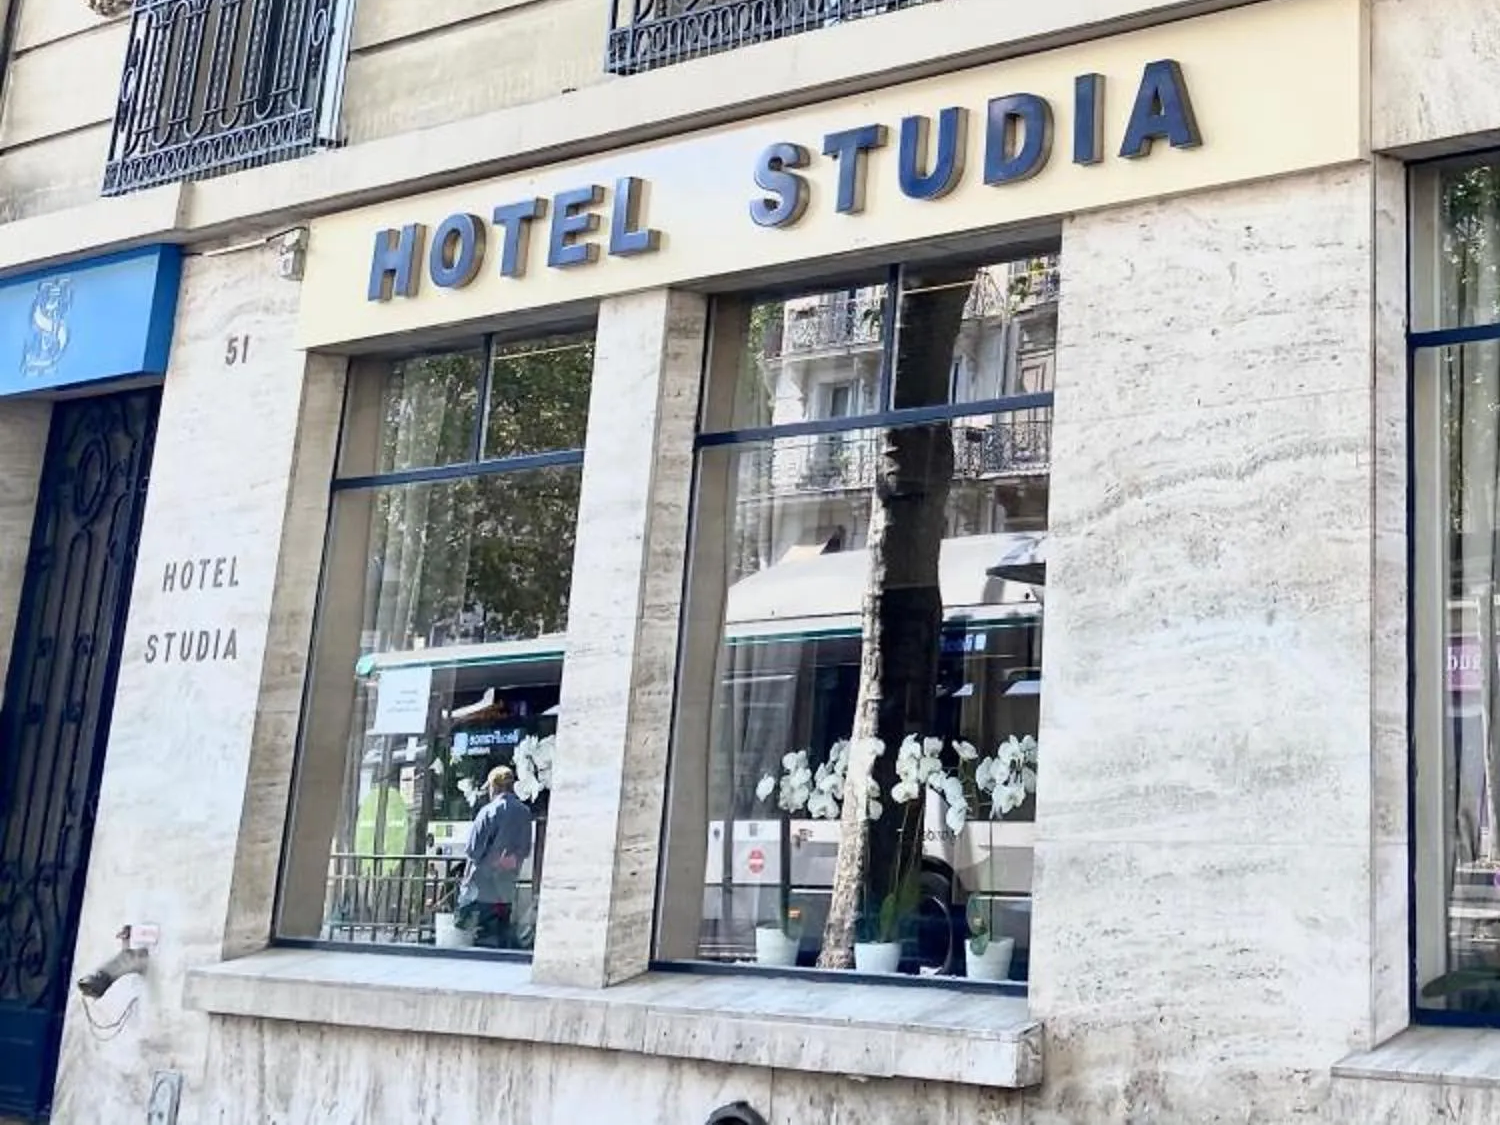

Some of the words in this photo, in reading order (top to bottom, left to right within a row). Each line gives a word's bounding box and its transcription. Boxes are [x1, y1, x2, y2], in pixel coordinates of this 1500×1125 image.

[367, 175, 661, 302] HOTEL
[748, 58, 1203, 229] STUDIA
[224, 335, 249, 365] 51
[162, 556, 240, 592] HOTEL
[144, 629, 238, 664] STUDIA
